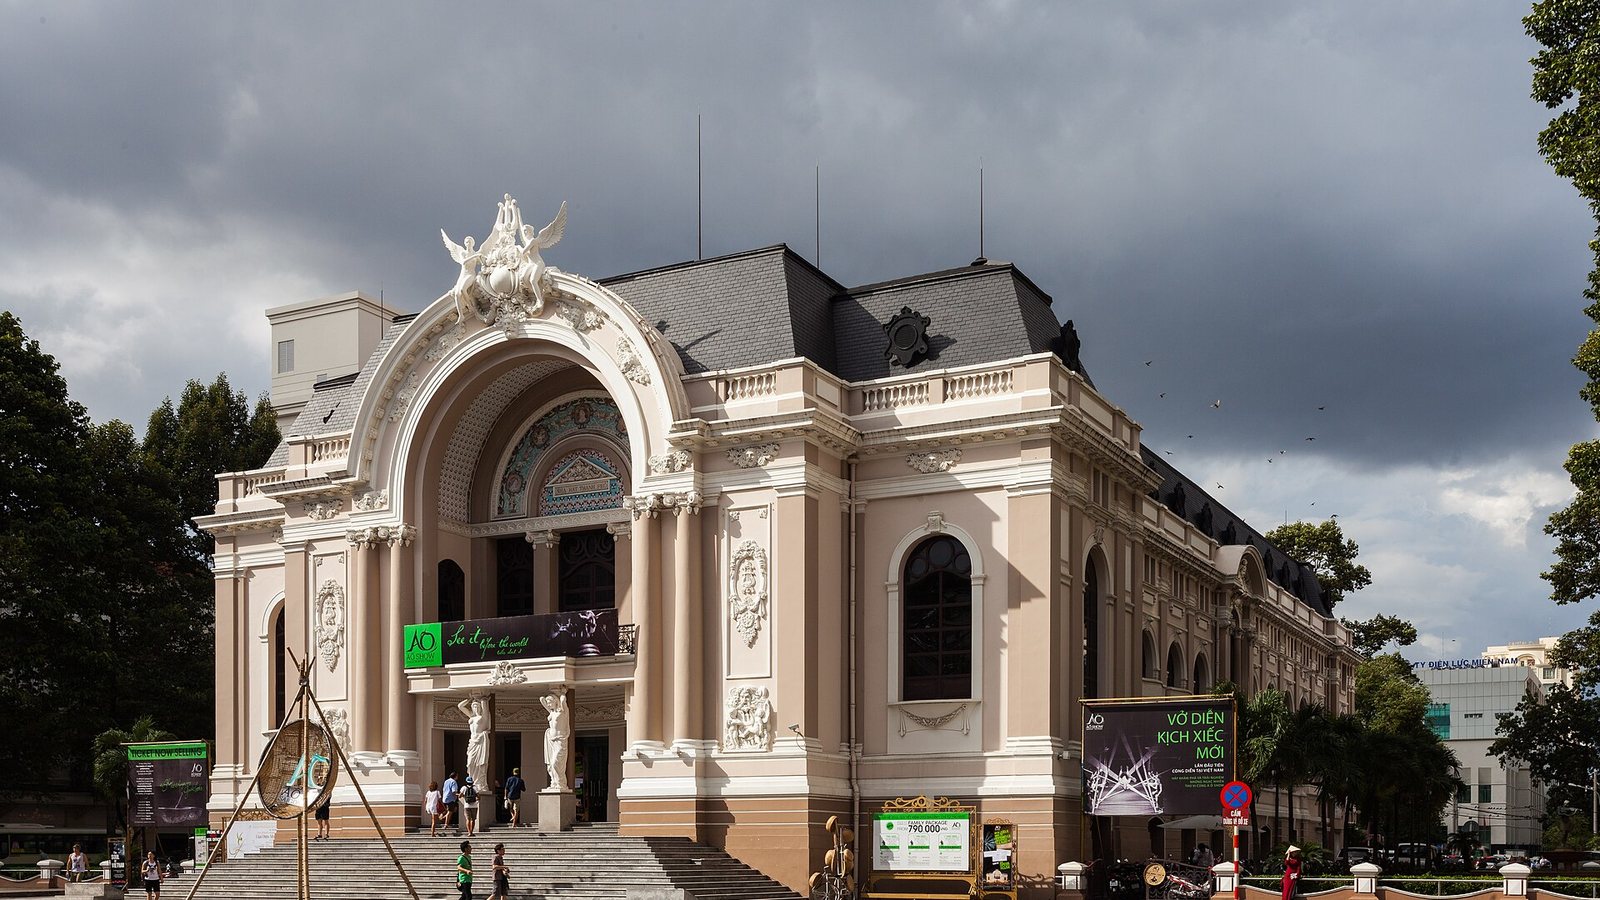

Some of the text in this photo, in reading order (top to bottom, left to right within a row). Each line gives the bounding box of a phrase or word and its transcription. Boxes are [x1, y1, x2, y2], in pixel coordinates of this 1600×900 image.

[447, 625, 487, 648] See it
[480, 637, 496, 659] before
[499, 636, 508, 648] the
[510, 637, 529, 647] world
[1497, 657, 1518, 665] NAM
[1167, 710, 1188, 726] VỞ
[1157, 726, 1224, 746] KỊCH XIẾC
[131, 748, 203, 758] TICKET NOW SELLING
[1196, 744, 1224, 759] MỚI
